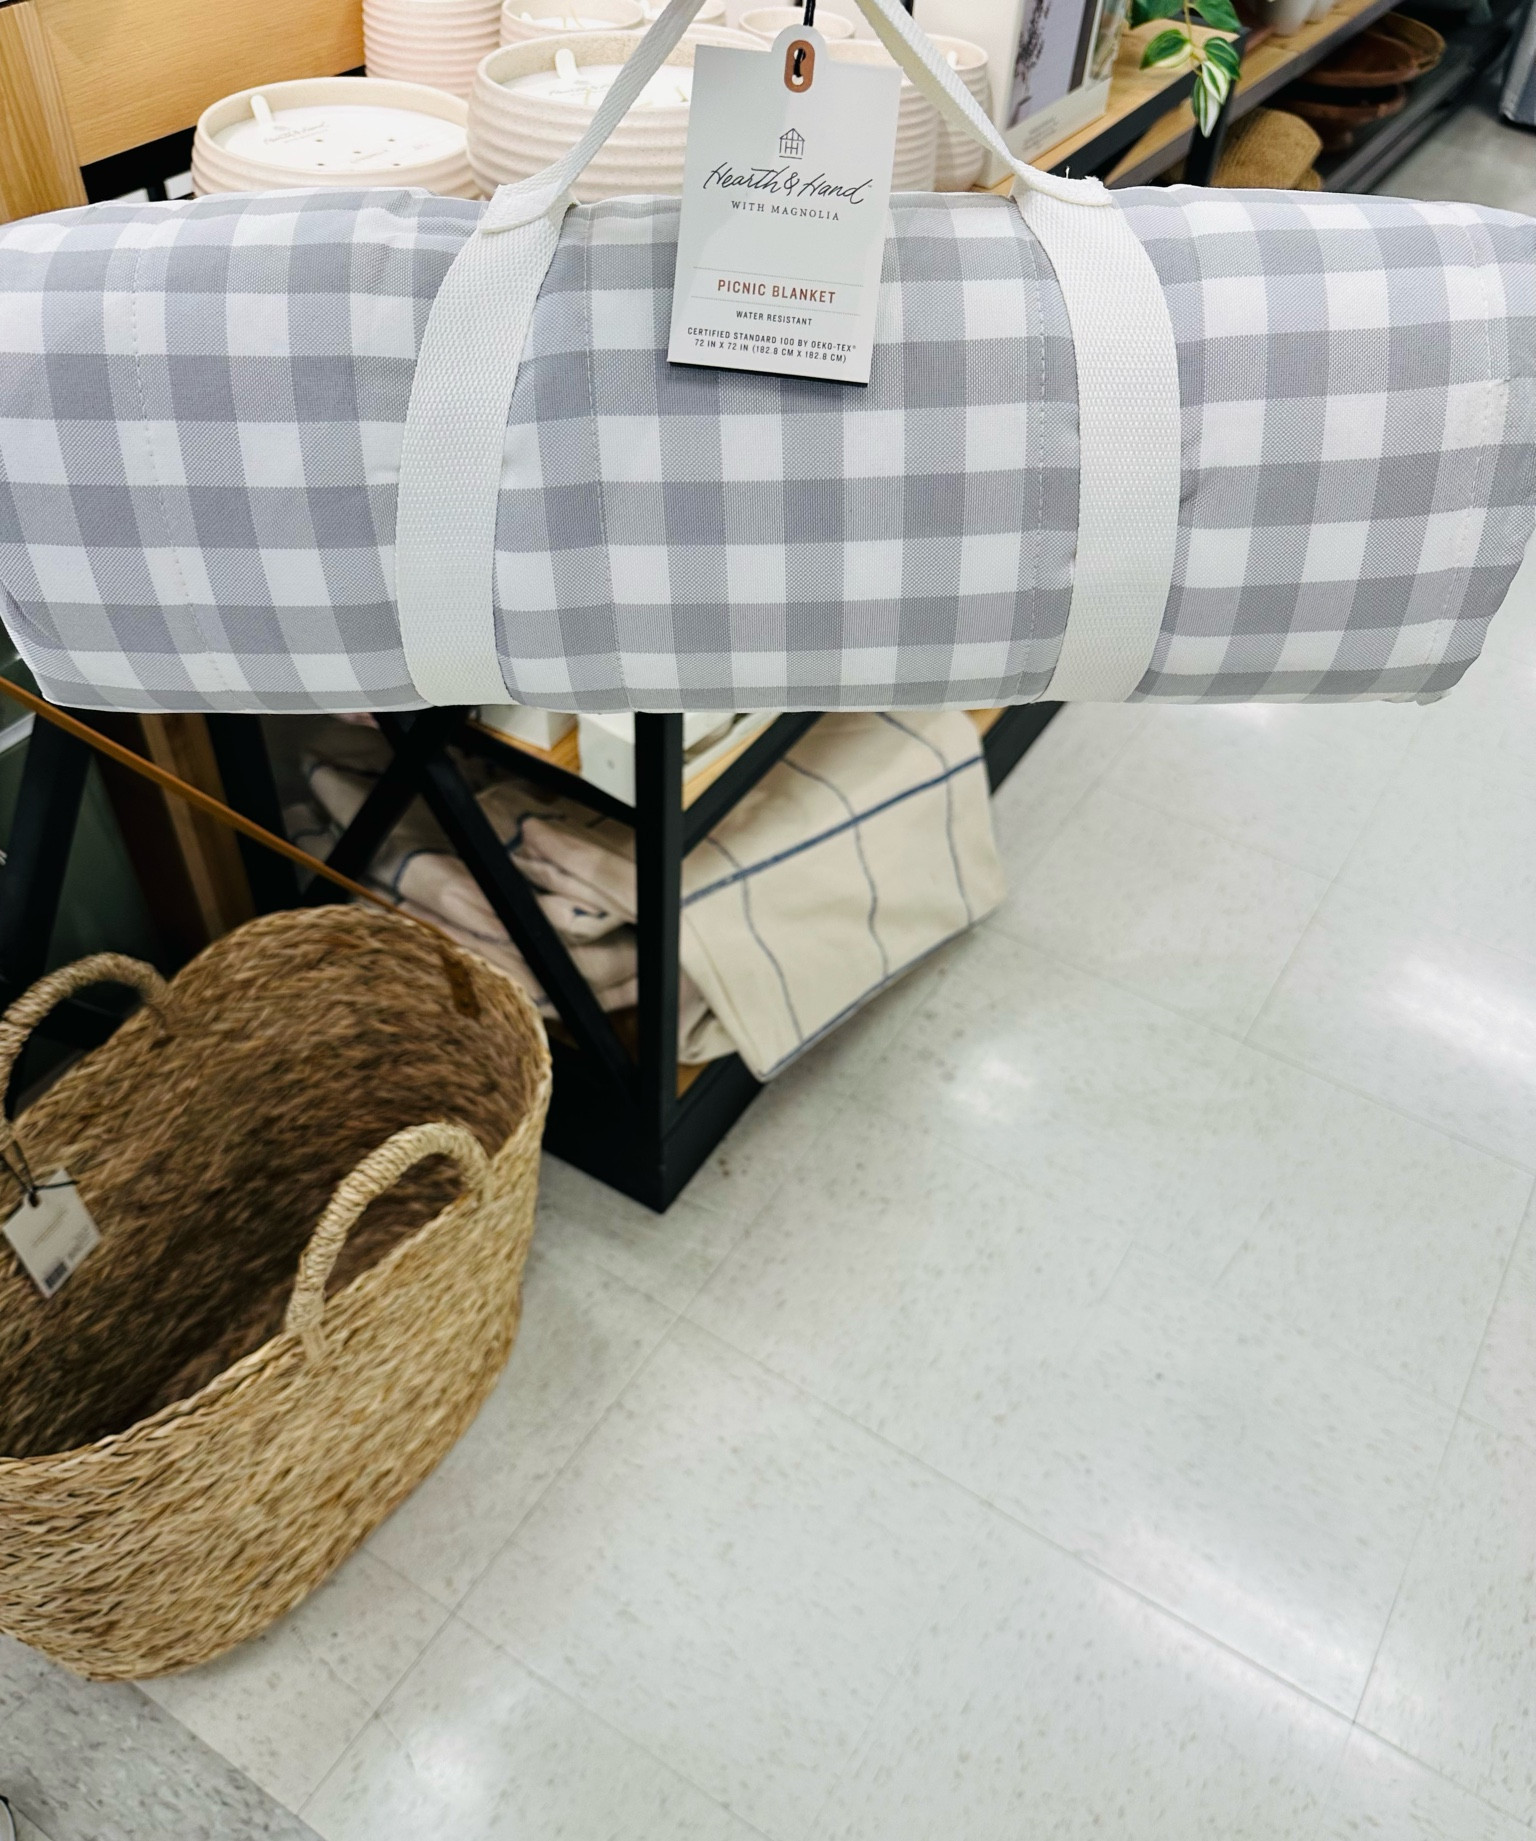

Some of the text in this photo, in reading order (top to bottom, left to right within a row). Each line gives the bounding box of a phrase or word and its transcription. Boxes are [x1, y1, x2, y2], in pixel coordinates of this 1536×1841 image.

[703, 161, 790, 194] Hearth
[783, 171, 800, 197] &
[731, 200, 839, 221] WITH MAGNOLIA
[717, 279, 836, 304] PICNIC BLANKET
[736, 310, 812, 326] WATER RESISTANT
[687, 327, 731, 339] CERTIFIED
[733, 332, 777, 344] STANDARD
[780, 337, 795, 346] 100
[797, 339, 808, 348] BY
[694, 338, 705, 347] 72
[707, 340, 716, 348] IN
[719, 341, 725, 349] X
[727, 342, 737, 351] 72
[739, 343, 749, 352] IN
[781, 348, 794, 356] CM
[796, 350, 804, 358] X
[805, 351, 828, 361] 182.8
[830, 353, 847, 364] CM)
